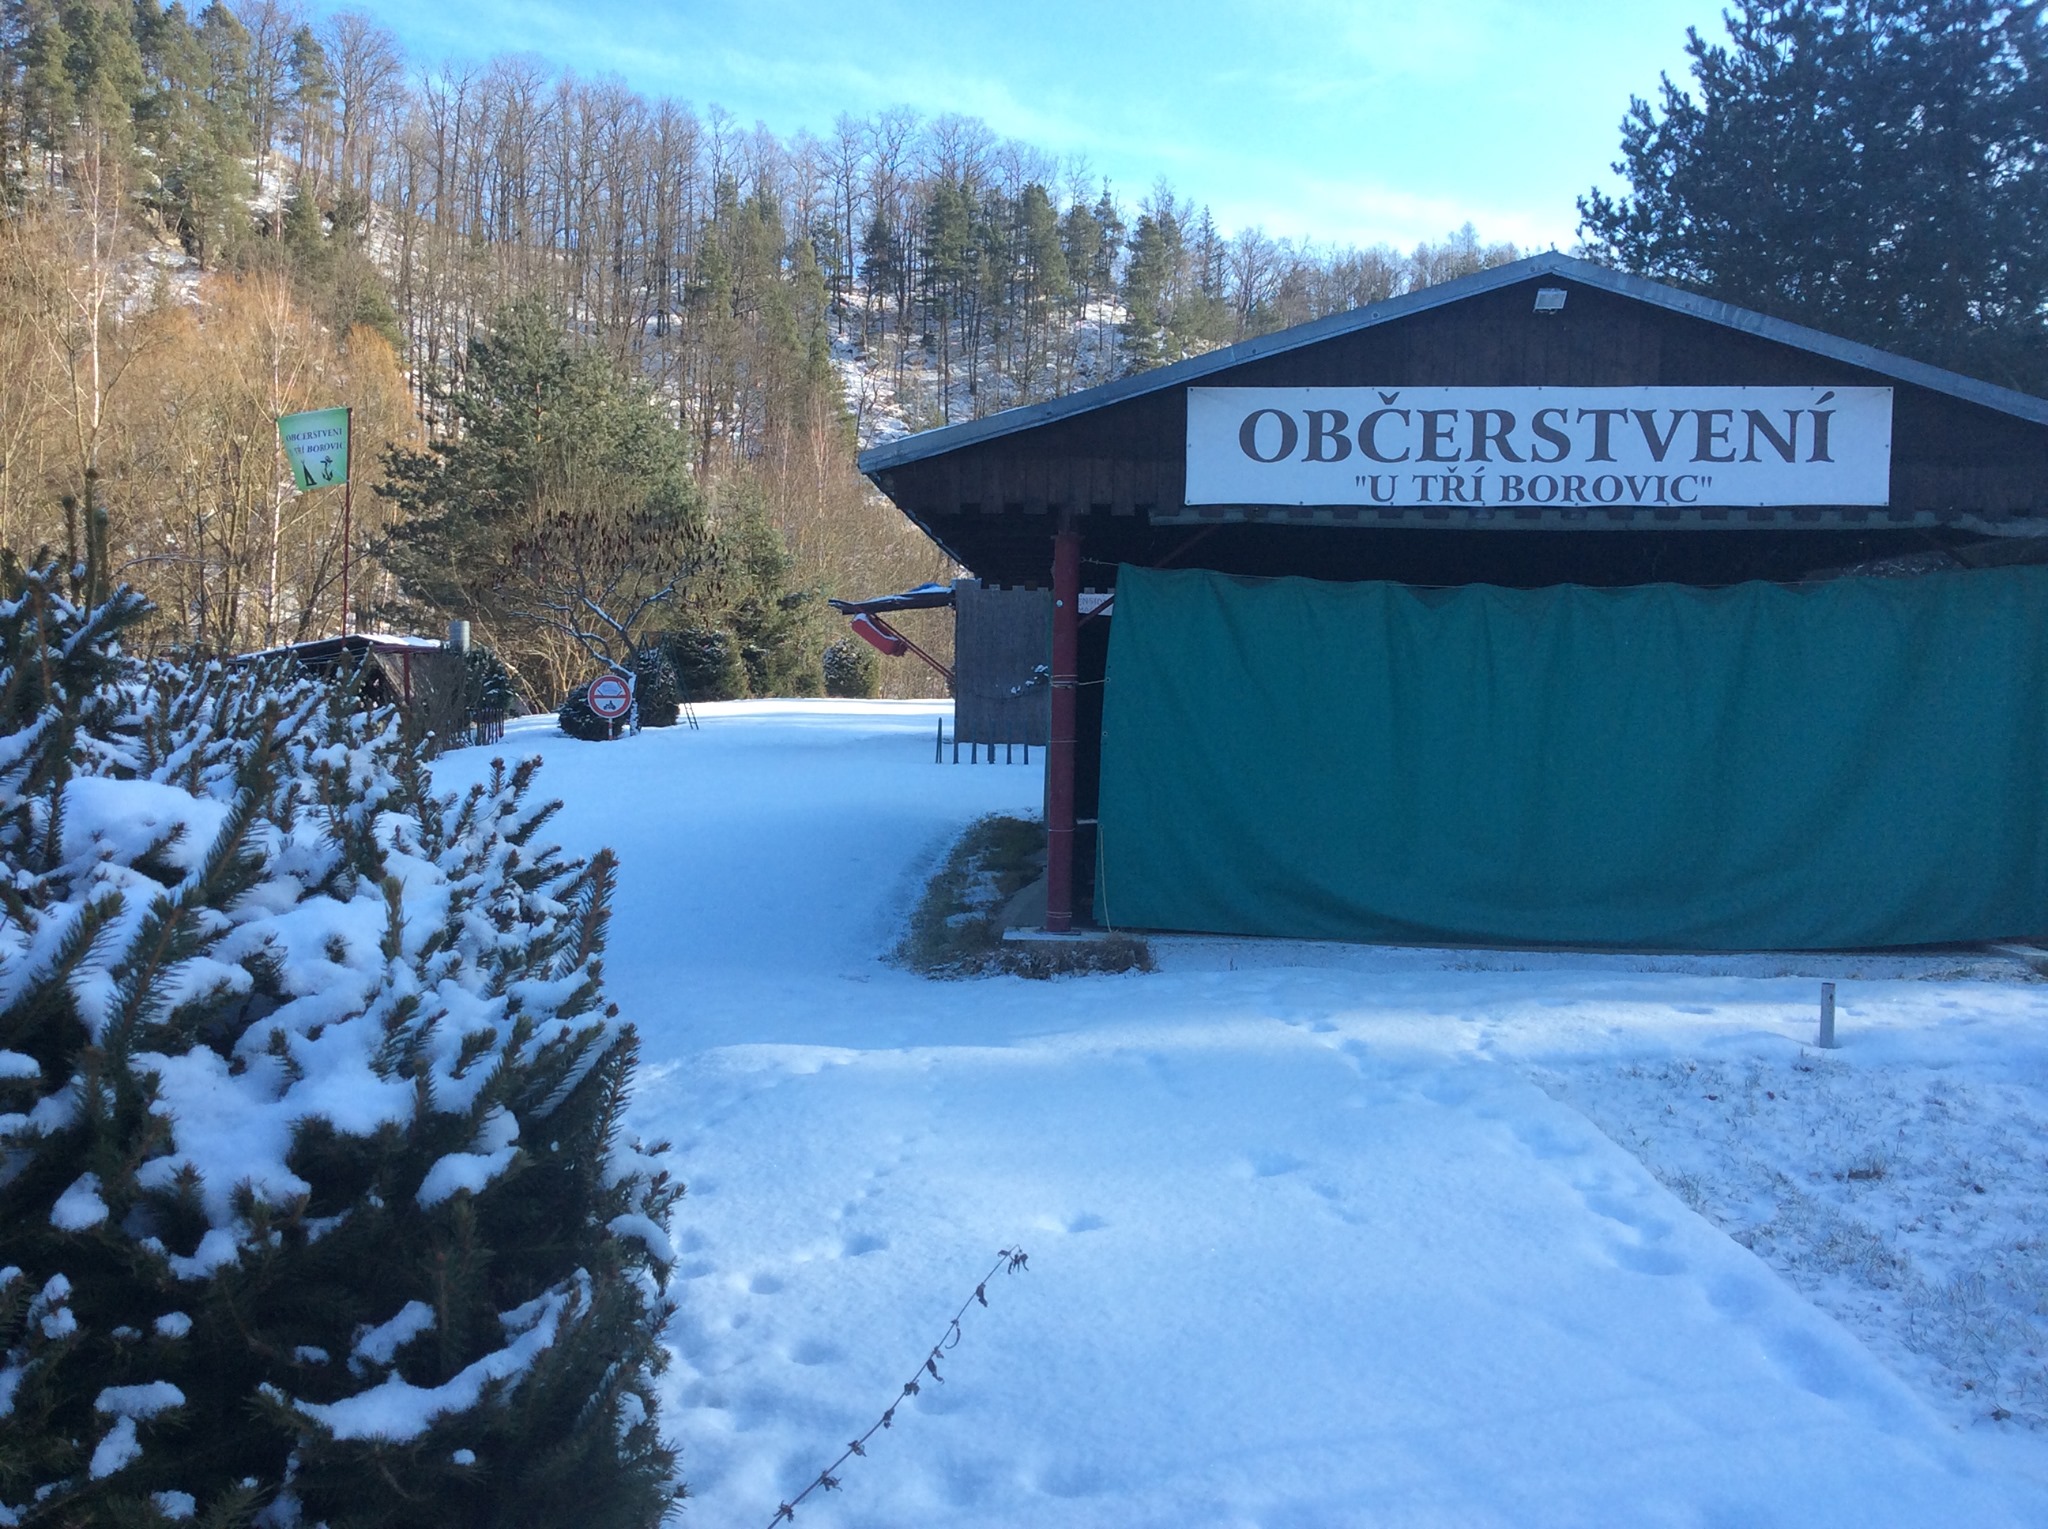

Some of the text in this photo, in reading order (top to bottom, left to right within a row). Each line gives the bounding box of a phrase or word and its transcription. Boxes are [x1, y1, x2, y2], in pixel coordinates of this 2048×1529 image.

[1238, 391, 1837, 464] OBČERSTVENÍ
[1355, 465, 1713, 504] "U TŘÍ BOROVIC"
